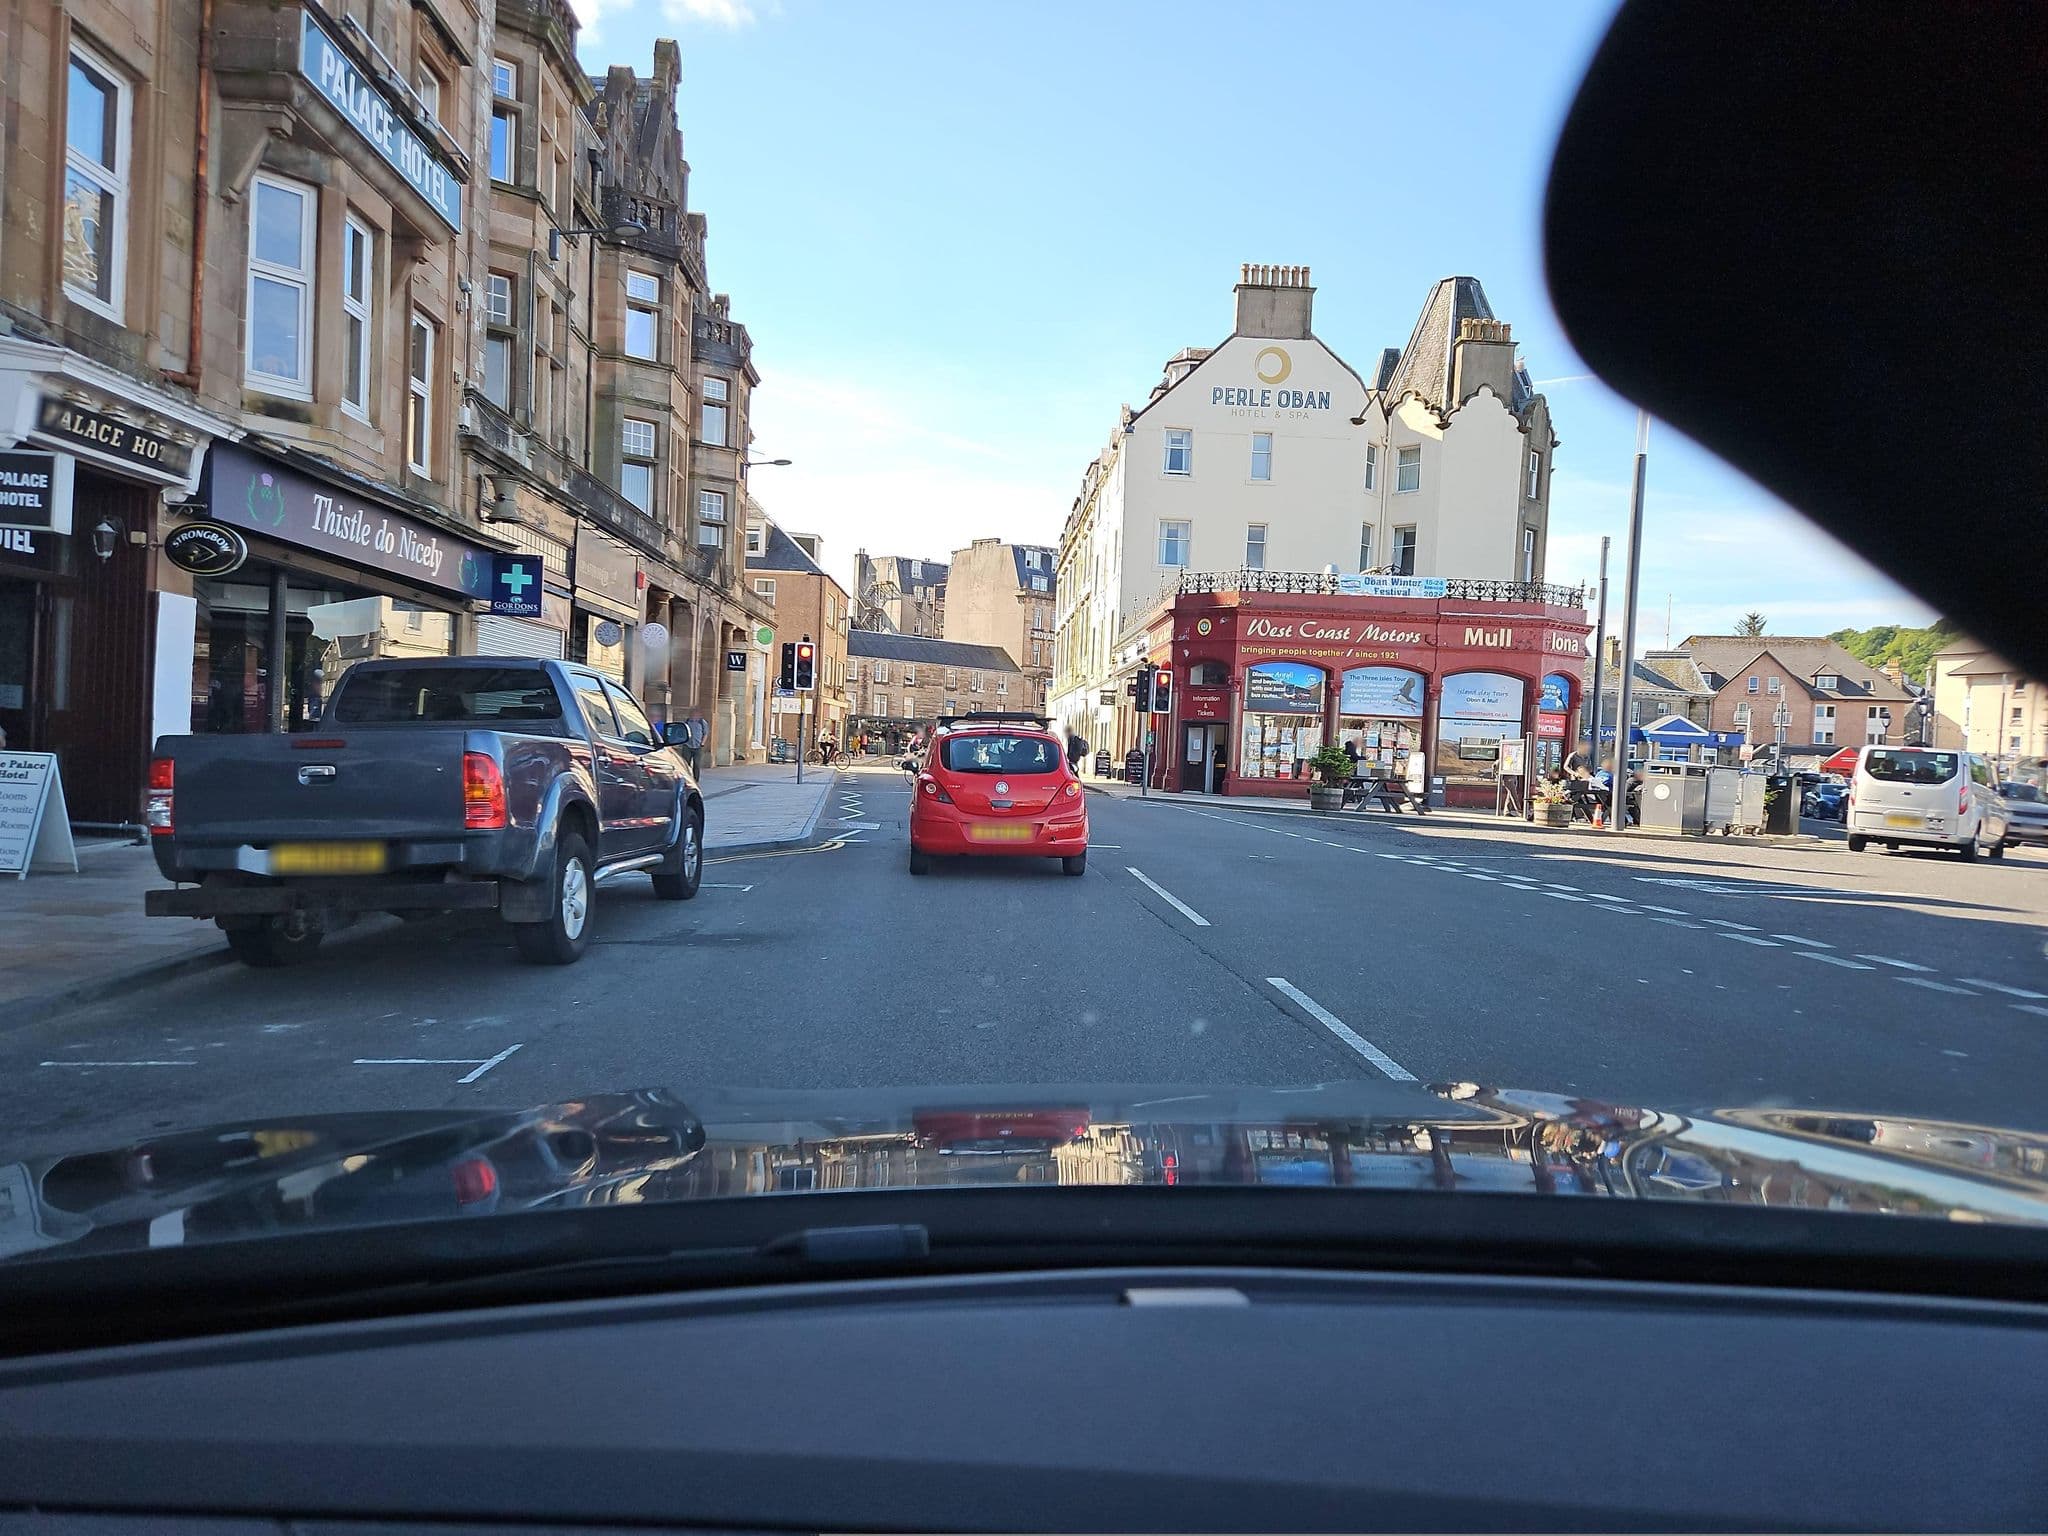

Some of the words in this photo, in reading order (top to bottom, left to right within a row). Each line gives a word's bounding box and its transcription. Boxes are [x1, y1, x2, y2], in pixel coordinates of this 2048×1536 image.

[321, 43, 393, 155] PALACE
[401, 131, 449, 211] HOTEL
[1212, 387, 1271, 408] PERLE
[1277, 390, 1331, 410] OBAN
[1231, 409, 1266, 418] HOTEL
[1274, 410, 1281, 418] &
[1289, 411, 1310, 419] SPA
[44, 405, 124, 447] ALACE
[0, 491, 42, 508] HOTEL
[0, 529, 35, 554] TEL
[172, 529, 233, 554] STRONGBOW
[312, 493, 371, 545] Thistle
[375, 520, 395, 553] do
[398, 527, 444, 577] Nicely
[1364, 577, 1387, 585] Oban
[1391, 578, 1422, 587] Winter
[1374, 588, 1411, 596] Festival
[494, 601, 539, 610] GORDONS
[1246, 618, 1293, 637] West
[1299, 621, 1351, 640] Coast
[1356, 624, 1421, 643] Motors
[1464, 627, 1513, 647] Mull
[1551, 632, 1579, 652] Iona
[730, 655, 744, 664] W
[1241, 646, 1276, 656] bringing
[1279, 648, 1307, 656] people
[1310, 648, 1344, 657] together
[9, 760, 46, 770] Palace
[0, 771, 29, 779] Hotel
